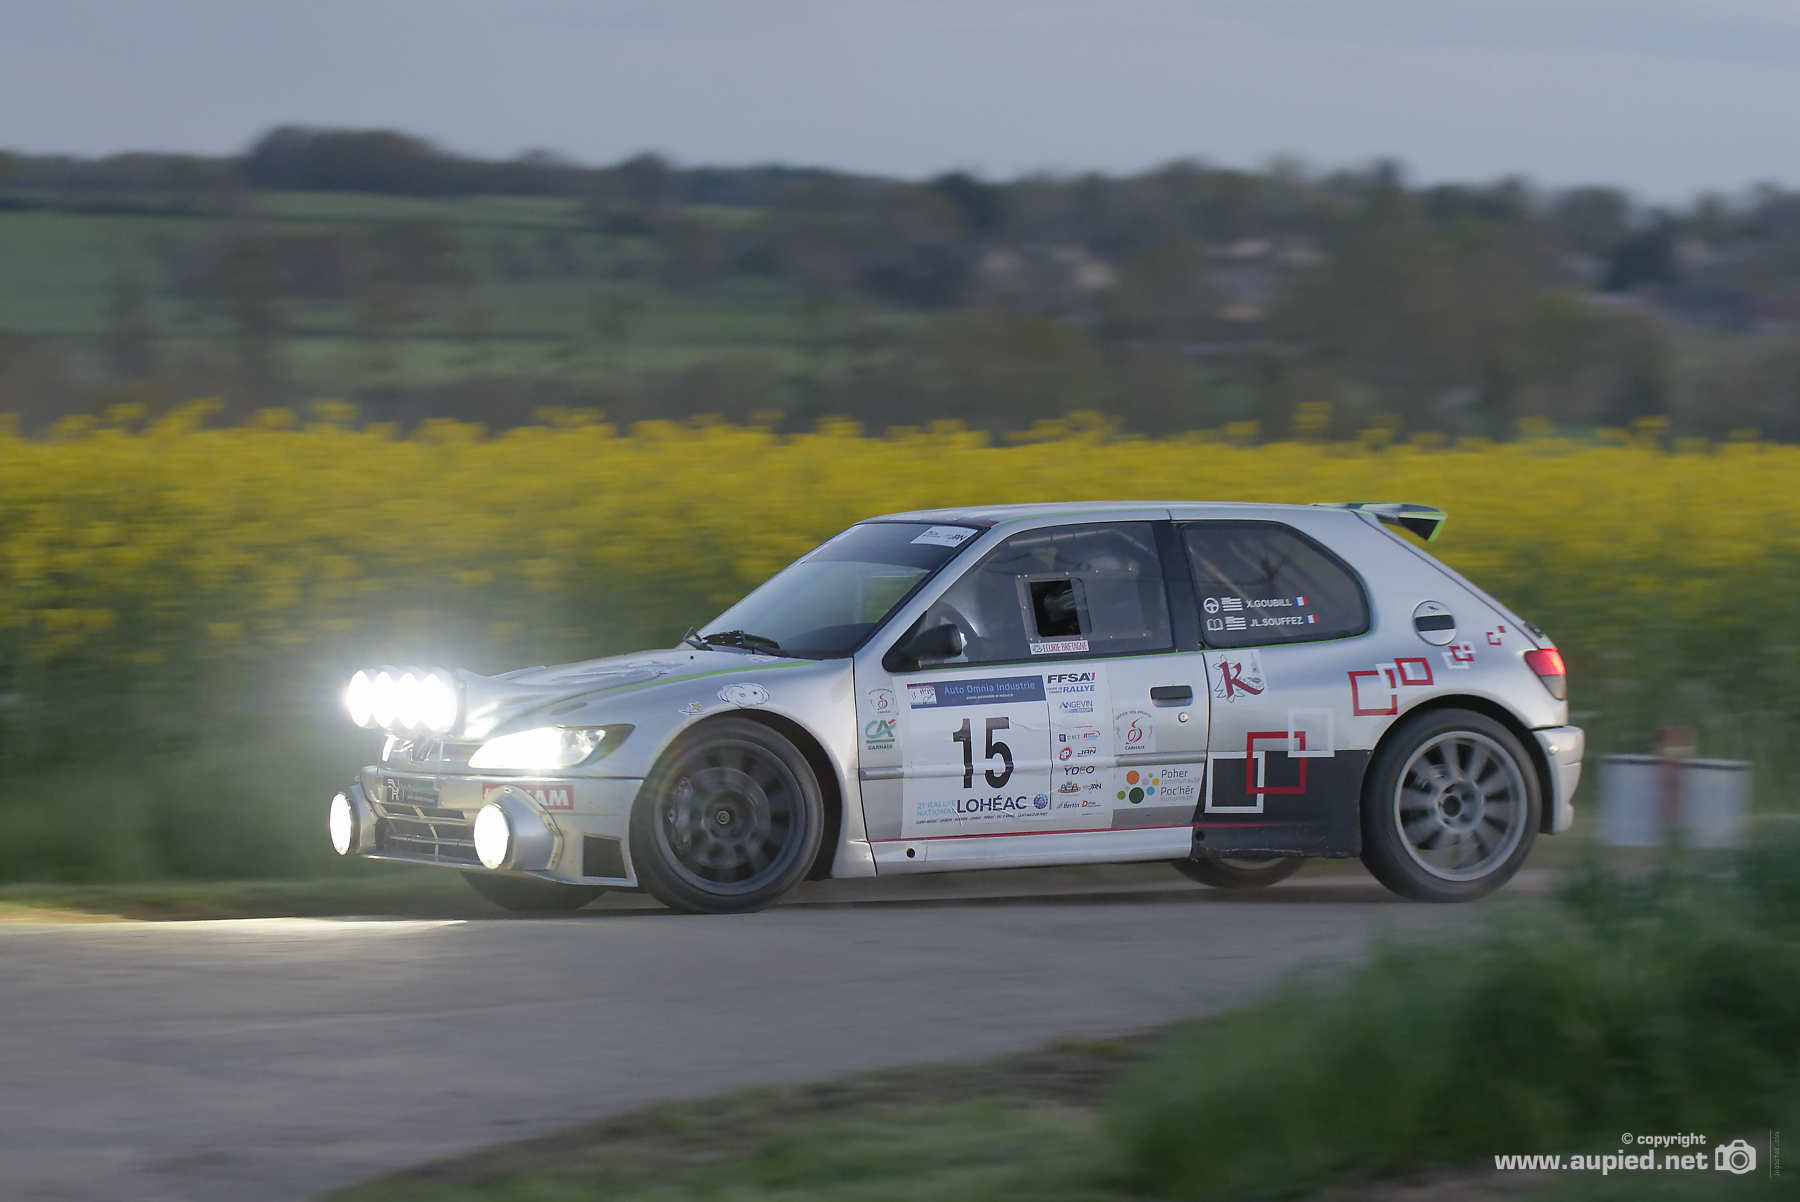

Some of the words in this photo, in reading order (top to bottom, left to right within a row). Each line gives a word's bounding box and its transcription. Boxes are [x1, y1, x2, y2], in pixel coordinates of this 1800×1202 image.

[944, 686, 965, 696] Auto
[966, 684, 994, 694] Omnia
[996, 681, 1036, 692] Industrie
[1063, 685, 1095, 693] RALLYE
[953, 716, 1014, 788] 15
[1161, 769, 1188, 779] Poher
[957, 794, 1027, 813] LOHÉAC
